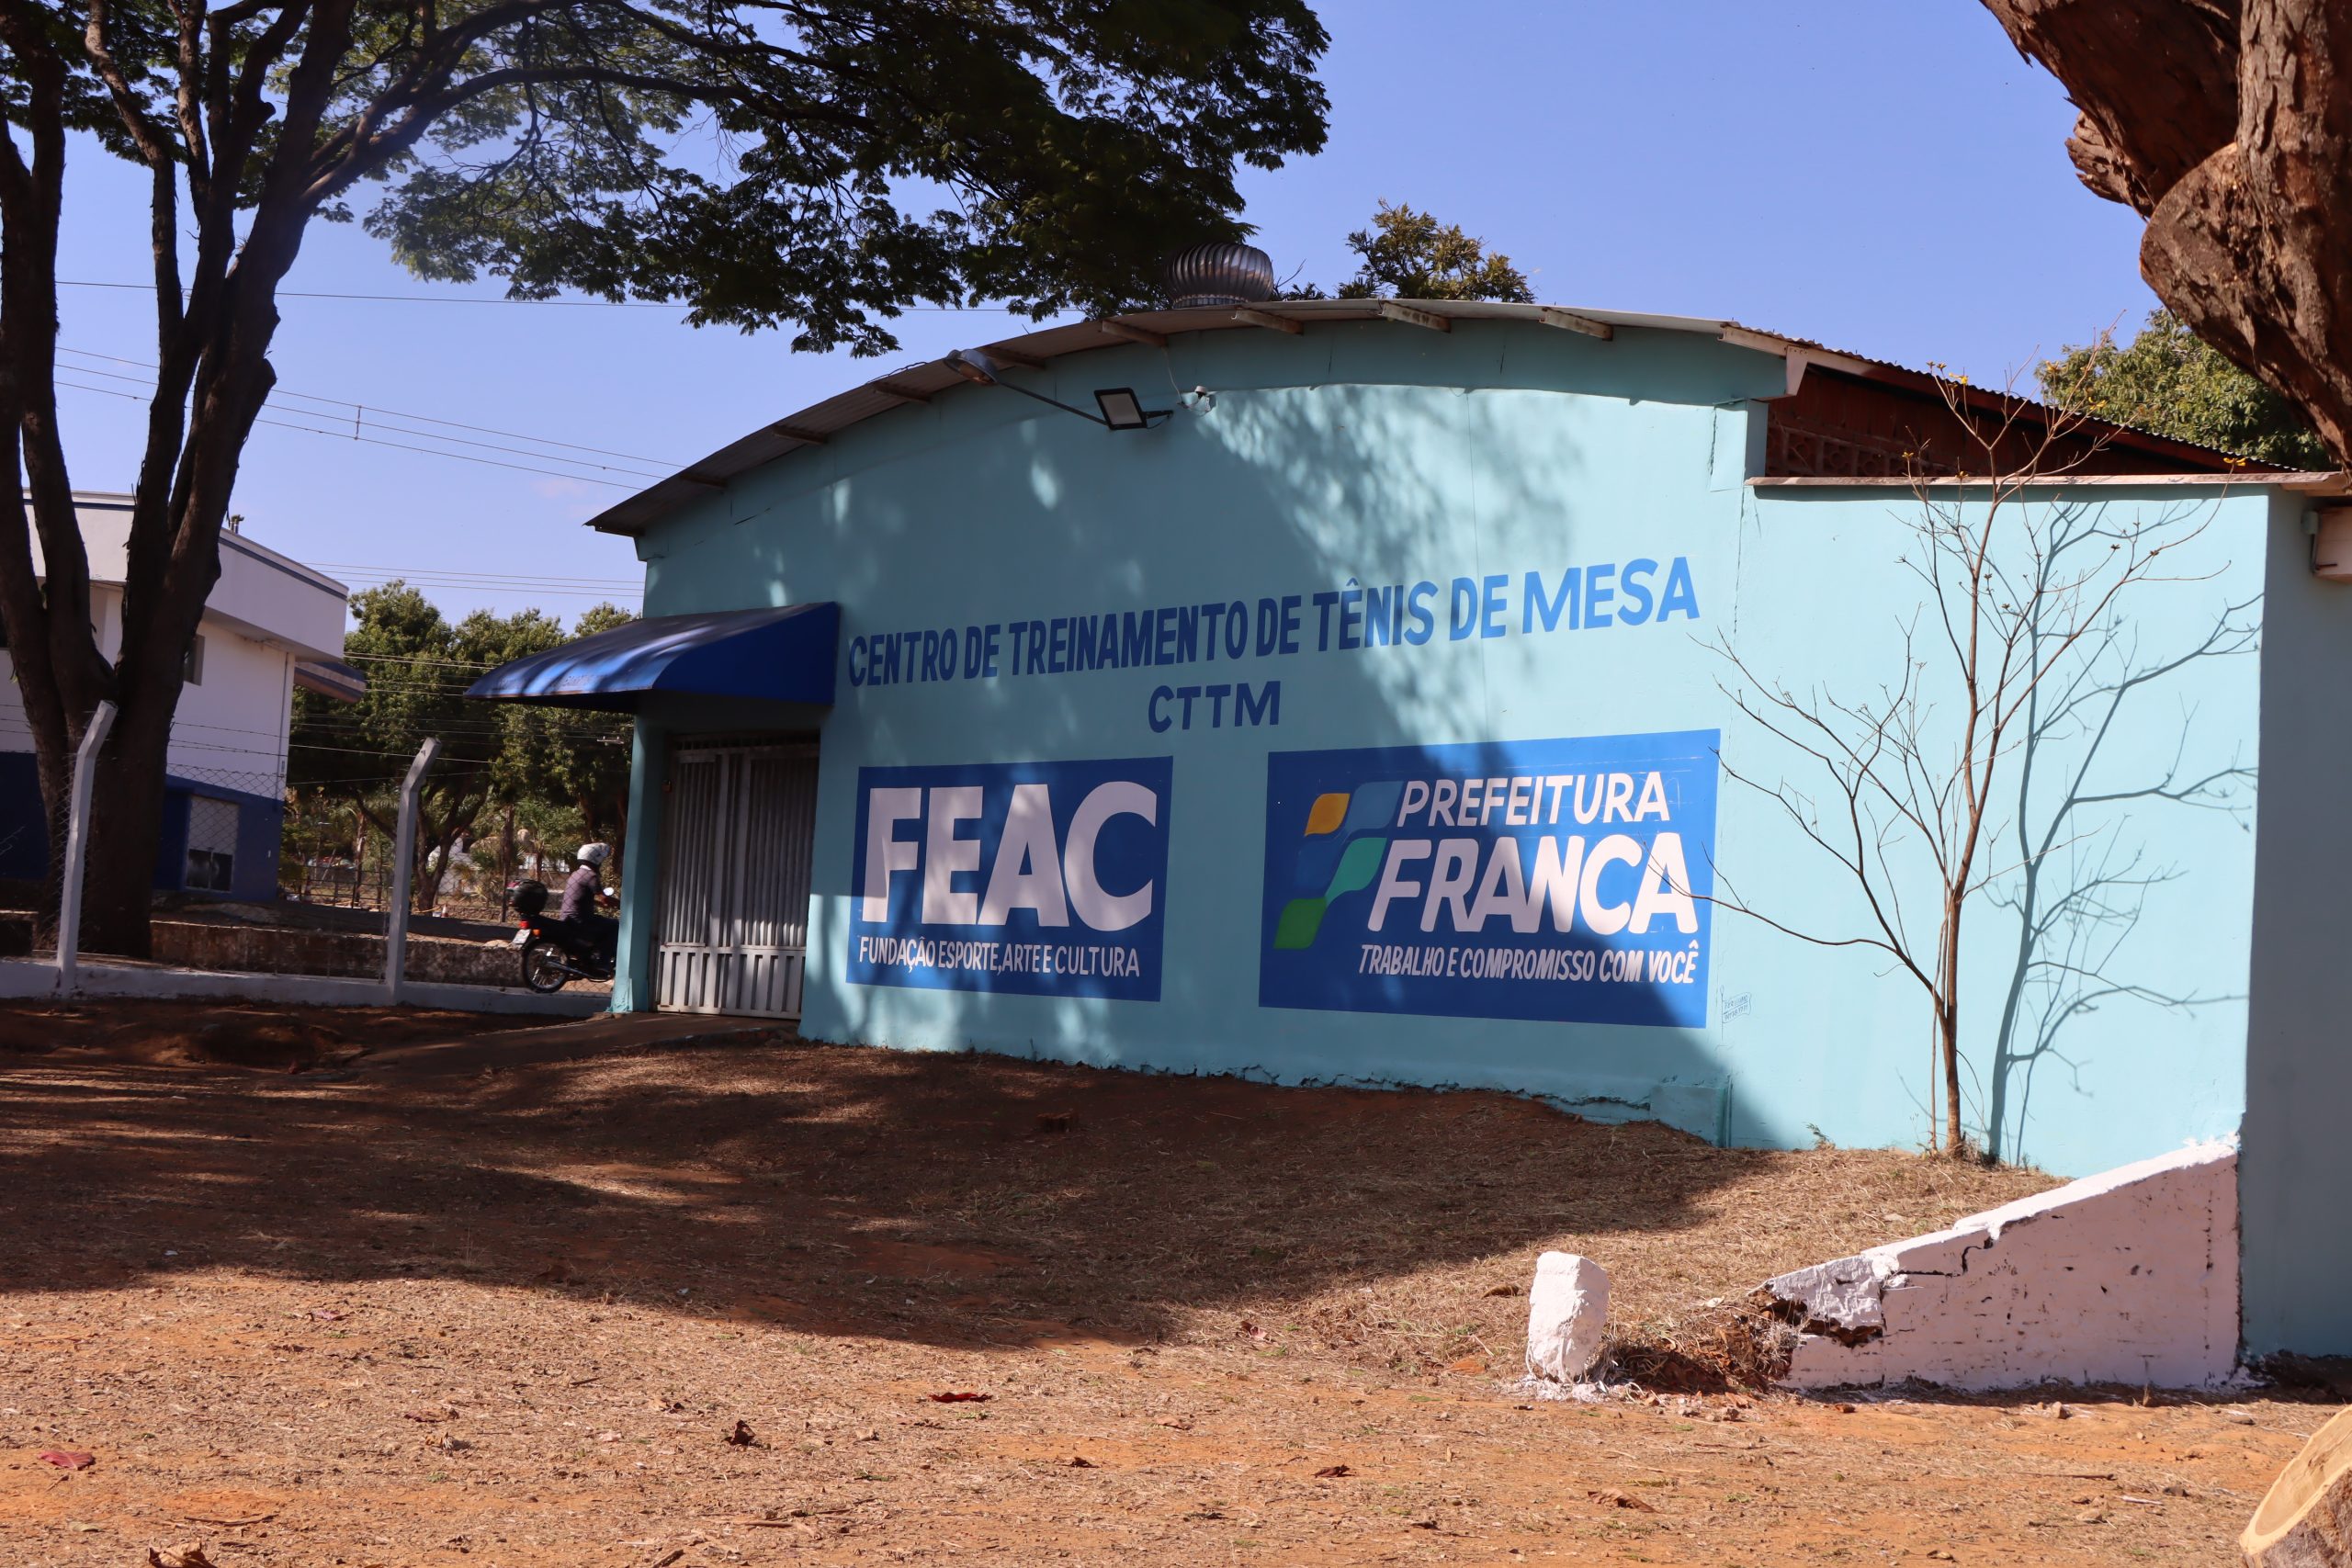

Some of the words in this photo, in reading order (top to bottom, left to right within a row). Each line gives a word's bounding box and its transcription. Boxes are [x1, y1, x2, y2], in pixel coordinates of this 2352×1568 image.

[849, 628, 957, 687] CENTRO
[964, 624, 1001, 680] DE
[1009, 600, 1249, 676] TREINAMENTO
[1255, 594, 1302, 657] DE
[1312, 577, 1439, 652] TÊNIS
[1449, 574, 1509, 641] DE
[1521, 556, 1701, 635] MESA
[1148, 681, 1281, 733] CTTM
[1396, 771, 1670, 828] PREFEITURA
[862, 781, 1157, 931] FEAC
[1367, 832, 1699, 935] FRANCA
[1055, 945, 1140, 977] CULTURA
[1358, 944, 1444, 977] TRABALHO
[1445, 947, 1459, 977] E
[1459, 947, 1596, 982] COMPROMISSO
[1599, 949, 1645, 983] COM
[1647, 939, 1699, 985] VOCÊ
